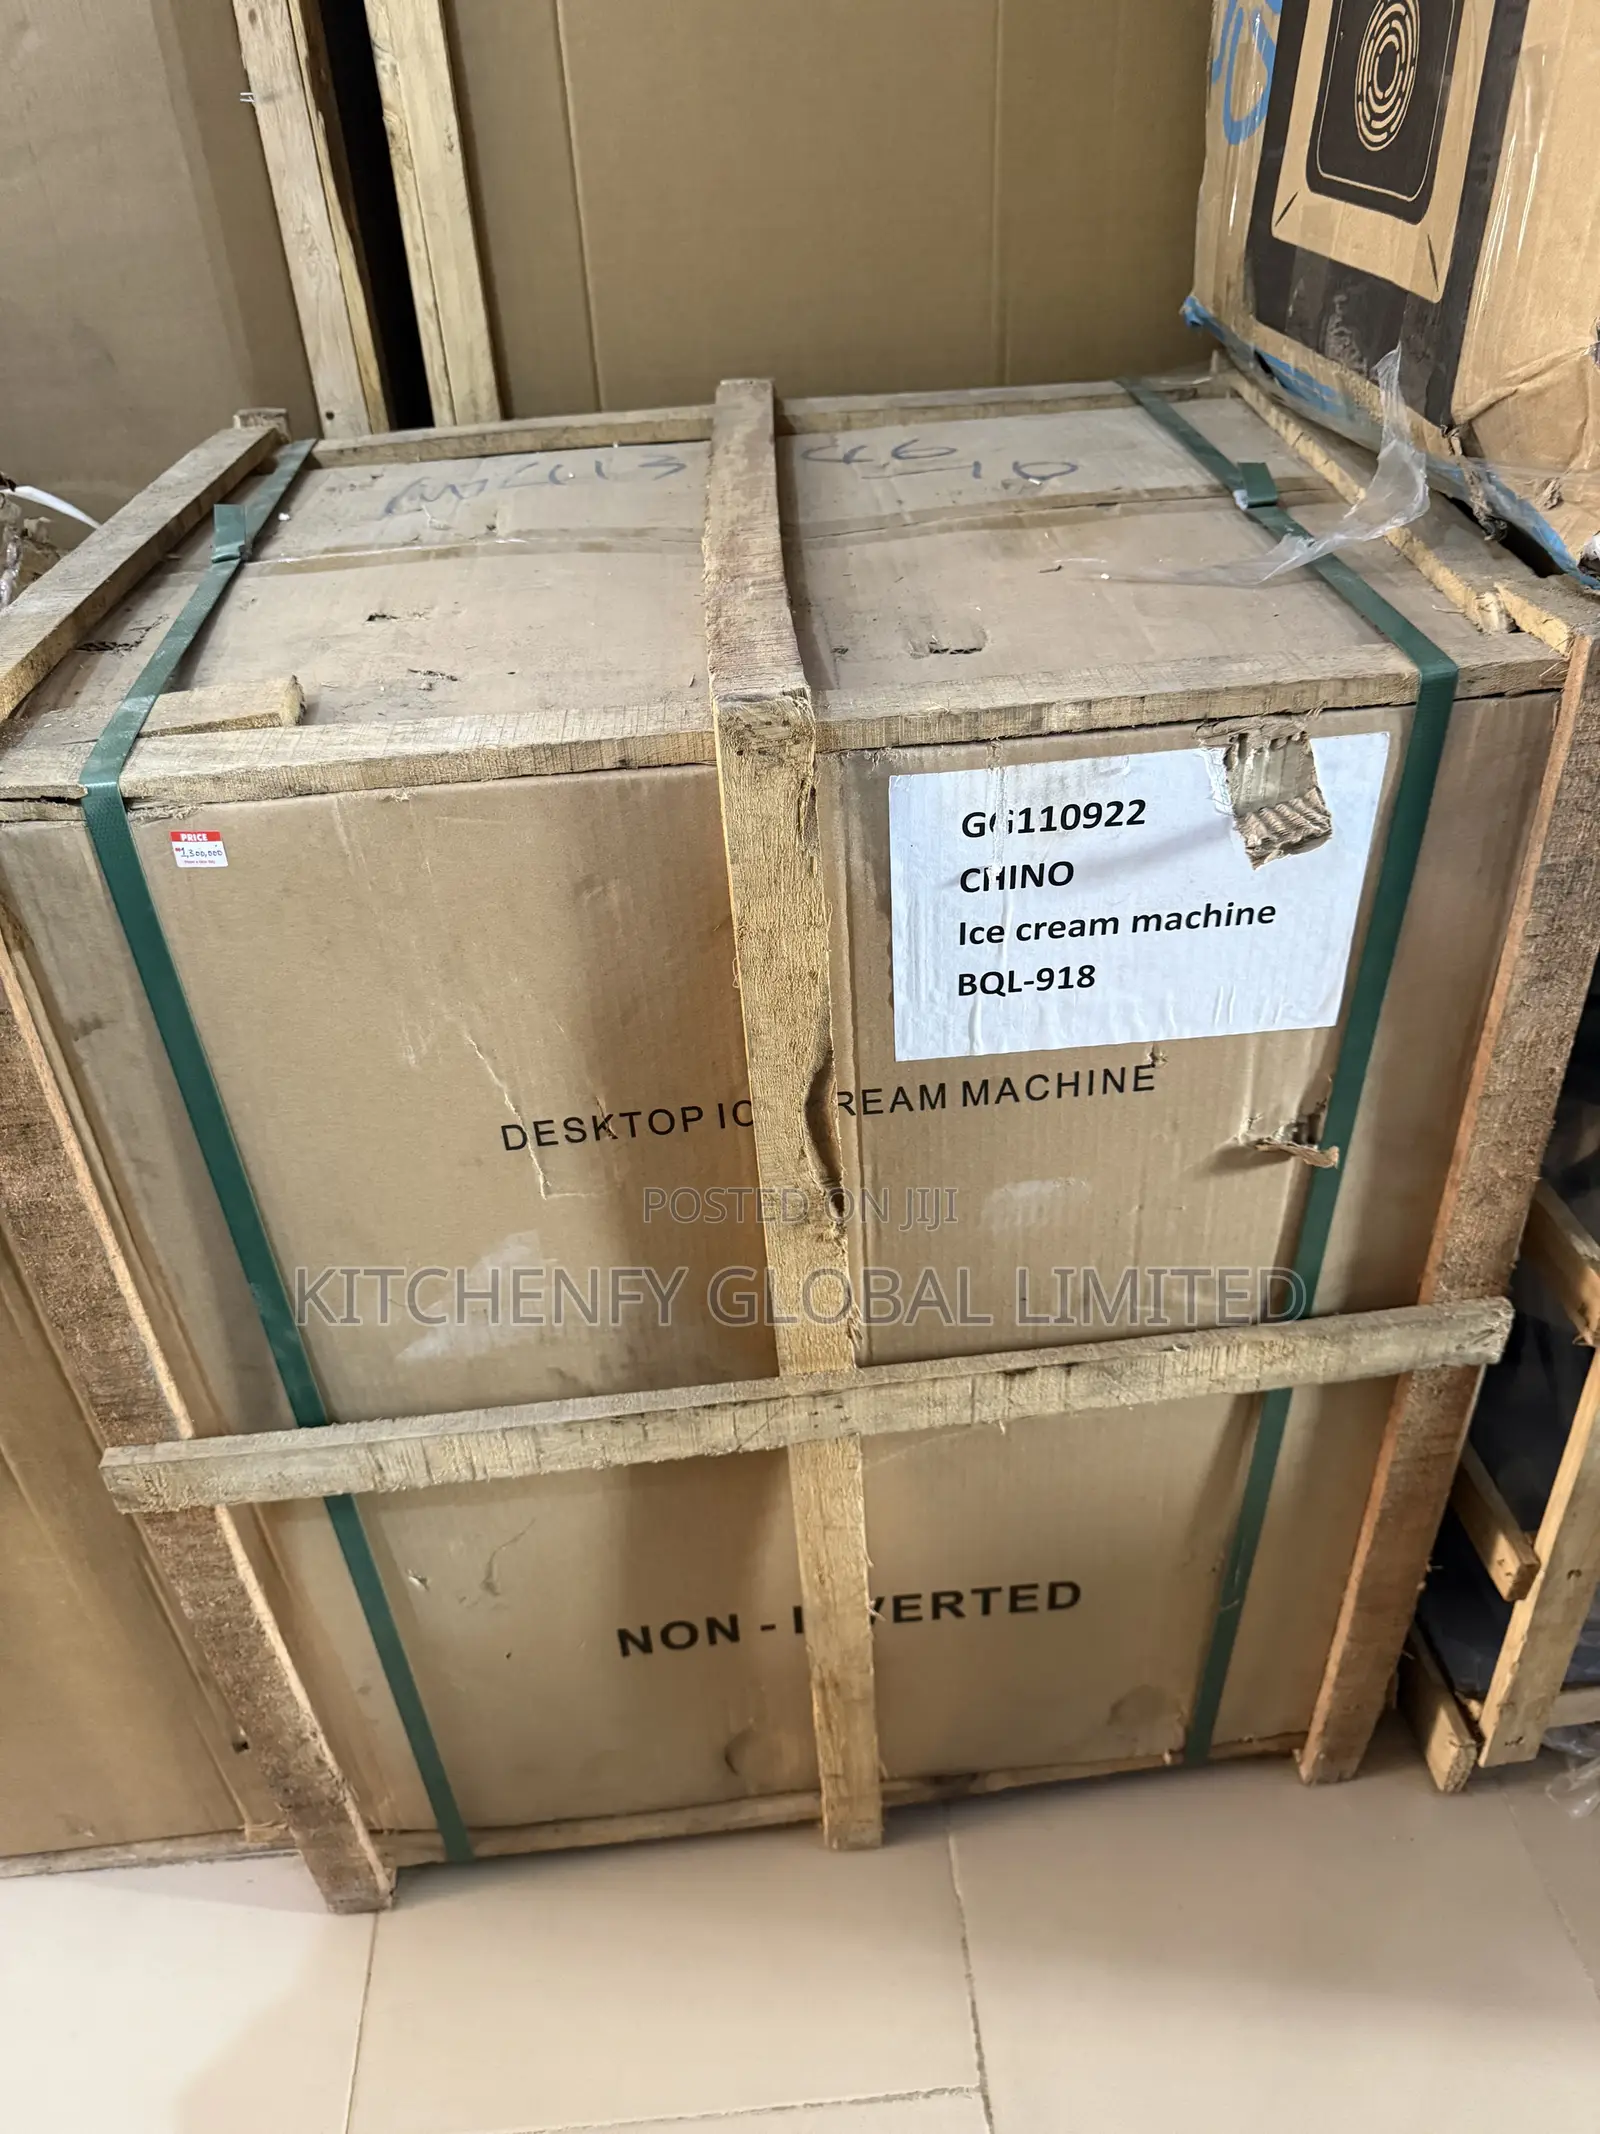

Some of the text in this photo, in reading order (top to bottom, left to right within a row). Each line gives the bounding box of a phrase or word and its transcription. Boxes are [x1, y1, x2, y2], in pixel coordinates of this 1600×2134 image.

[180, 833, 208, 842] PRICE
[959, 860, 1075, 893] CHINO
[959, 901, 1277, 946] Ice cream machine
[957, 964, 1096, 997] BQL-918
[500, 1105, 704, 1151] DESKTOP
[837, 1083, 947, 1116] REAM
[962, 1063, 1156, 1108] MACHINE
[617, 1613, 741, 1657] NON
[793, 1581, 1081, 1634] IERTED
